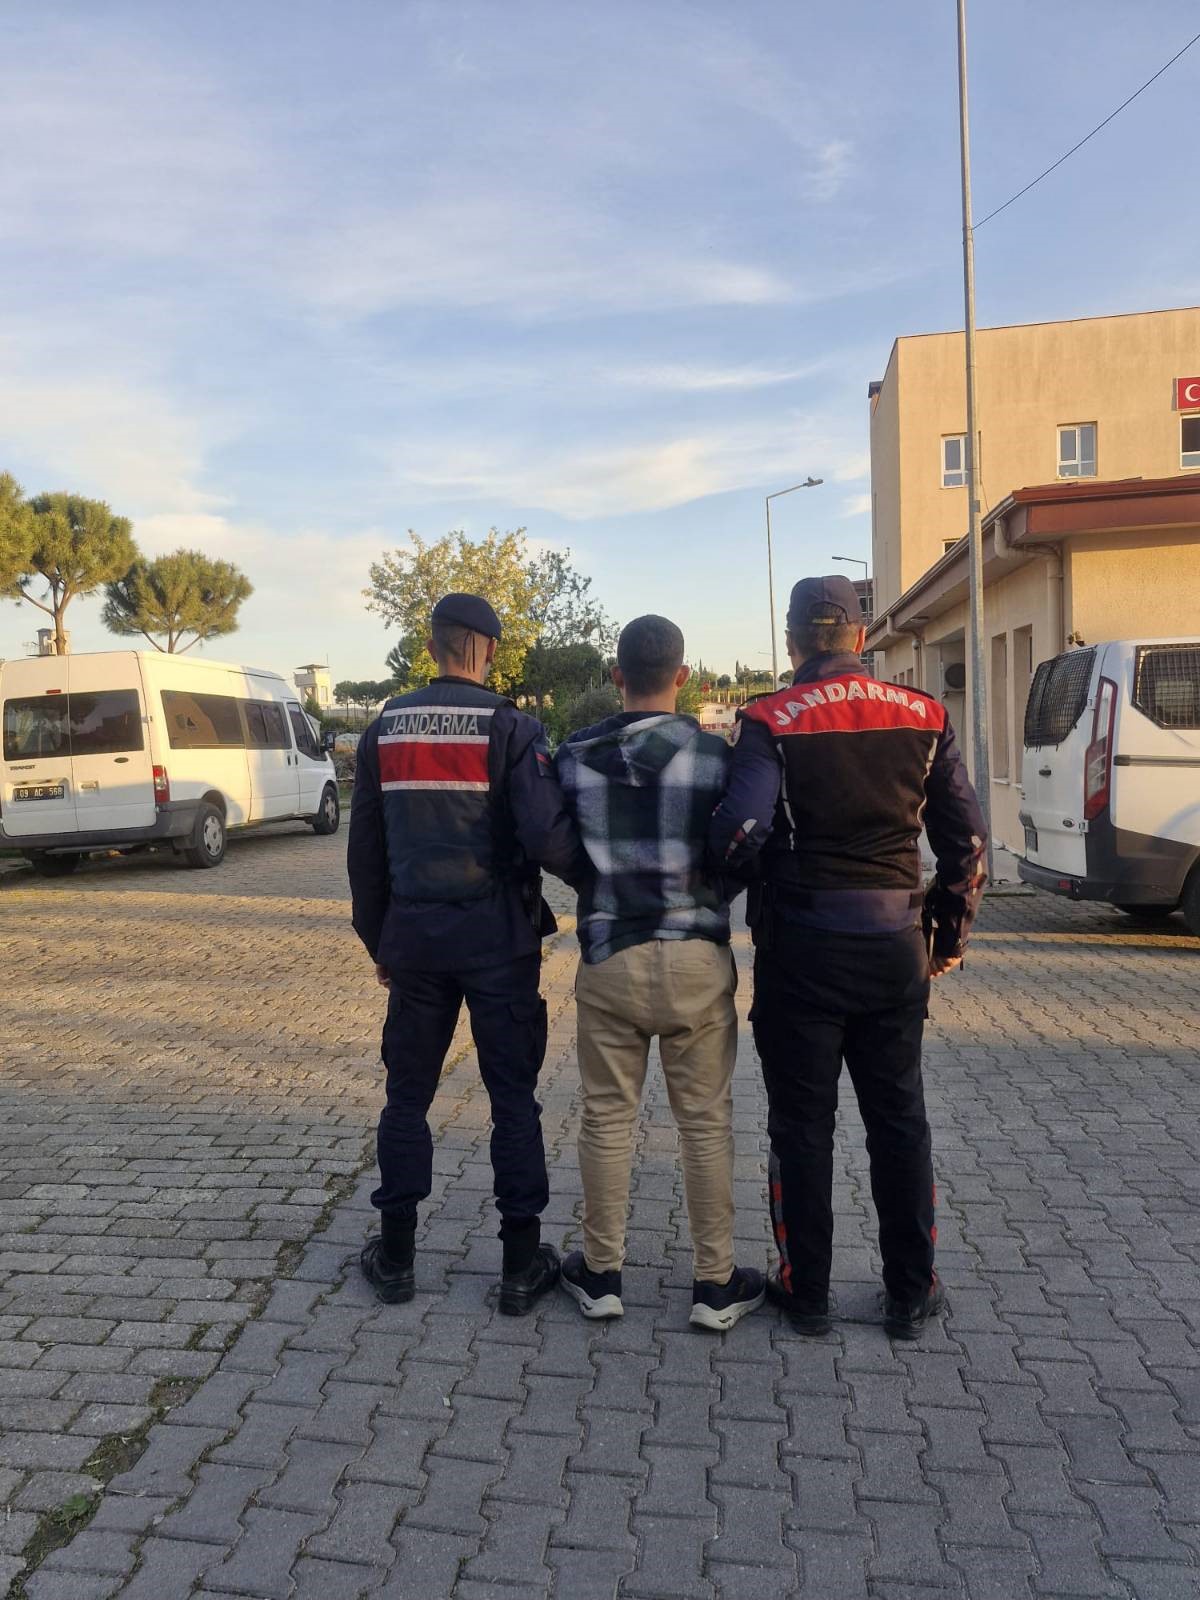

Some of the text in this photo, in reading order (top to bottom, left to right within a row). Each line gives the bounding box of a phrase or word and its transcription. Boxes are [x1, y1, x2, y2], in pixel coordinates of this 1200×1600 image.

[774, 681, 927, 726] JANDARMA
[387, 714, 479, 735] JANDARMA
[19, 788, 29, 798] 09
[34, 787, 43, 797] AC
